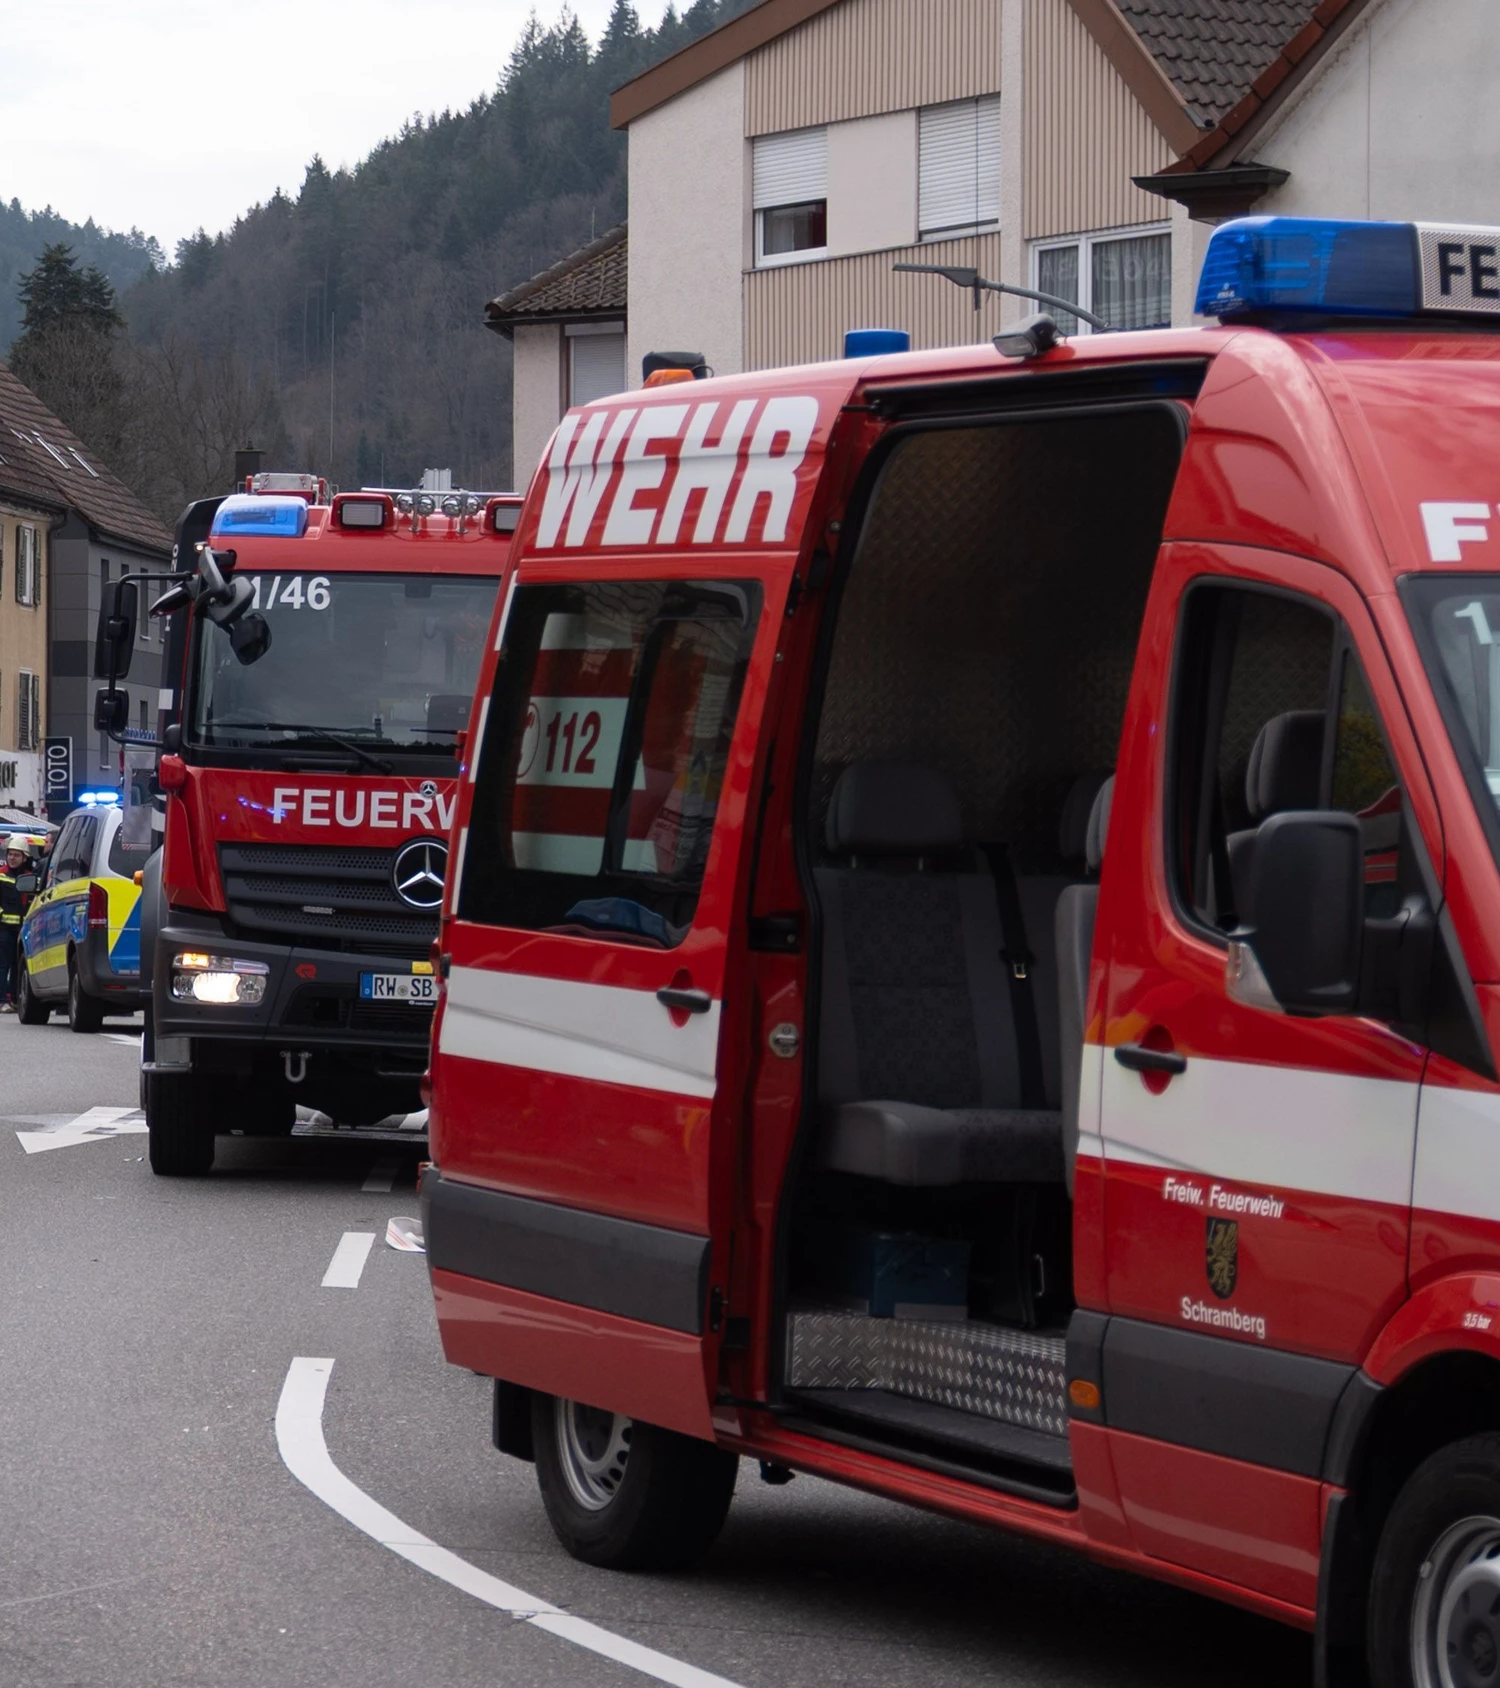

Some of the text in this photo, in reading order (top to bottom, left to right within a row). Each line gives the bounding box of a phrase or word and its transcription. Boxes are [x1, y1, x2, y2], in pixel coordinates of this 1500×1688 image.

[535, 396, 819, 549] WEHR
[546, 711, 601, 774] 112
[47, 745, 68, 793] TOTO
[374, 977, 397, 996] RW
[411, 978, 432, 997] SB
[1164, 1177, 1285, 1219] Freiw. Feuerwehr
[1181, 1296, 1266, 1339] Schramberg
